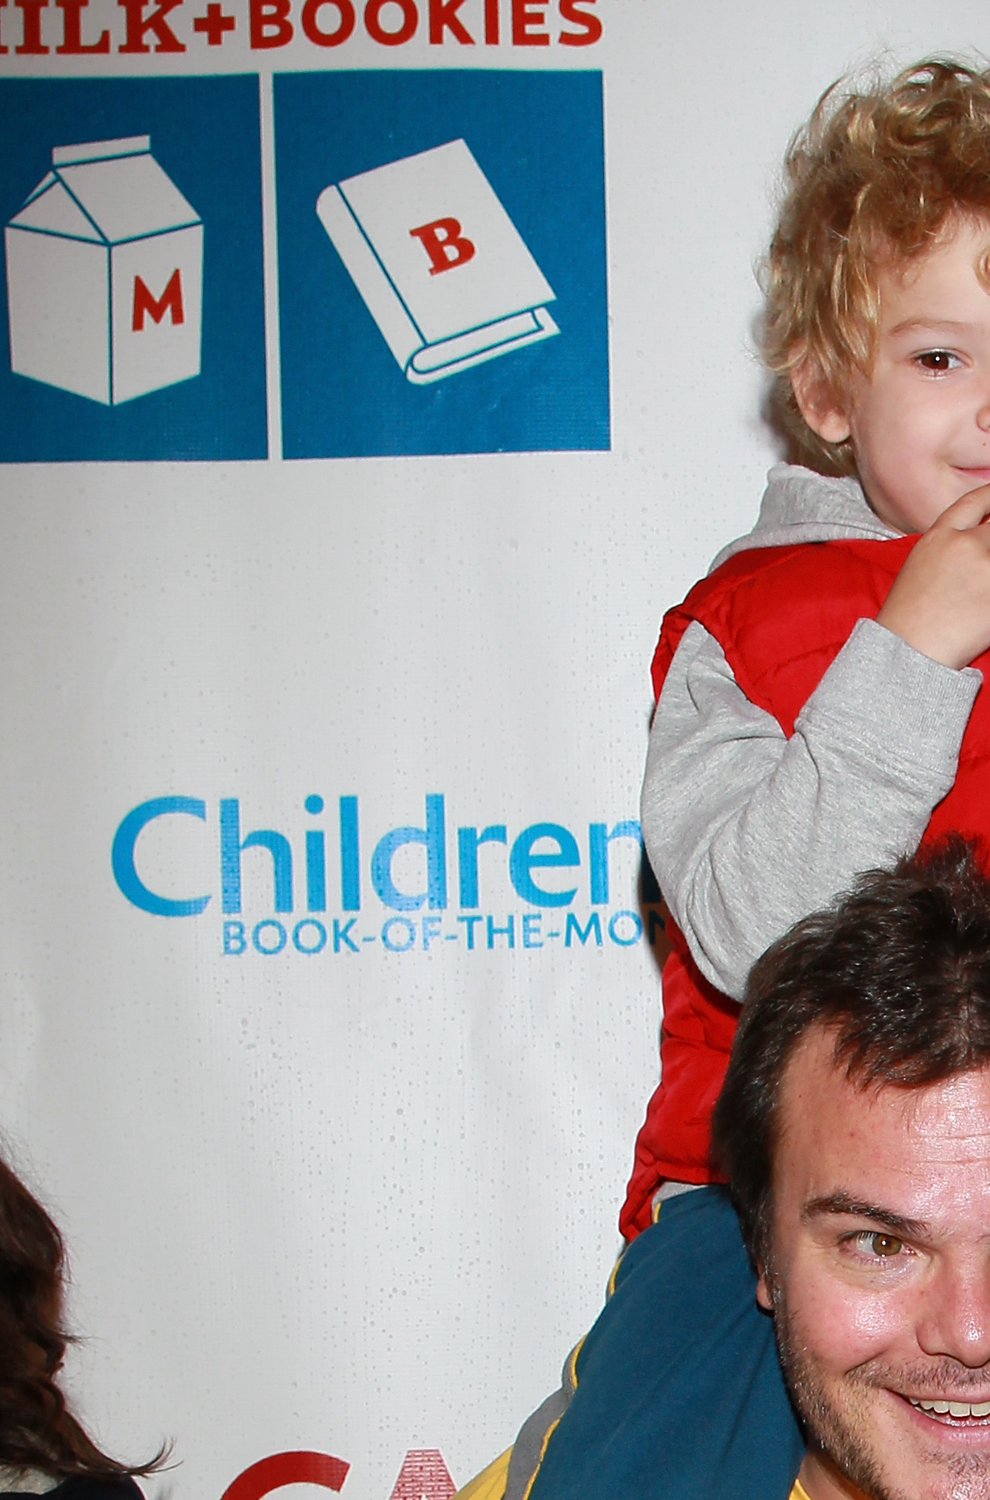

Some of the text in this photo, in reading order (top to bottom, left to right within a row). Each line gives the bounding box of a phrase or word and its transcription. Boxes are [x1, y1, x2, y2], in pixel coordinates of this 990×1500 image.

[0, 0, 602, 54] ILK+BOOKIES
[410, 217, 476, 277] B
[132, 268, 184, 332] M
